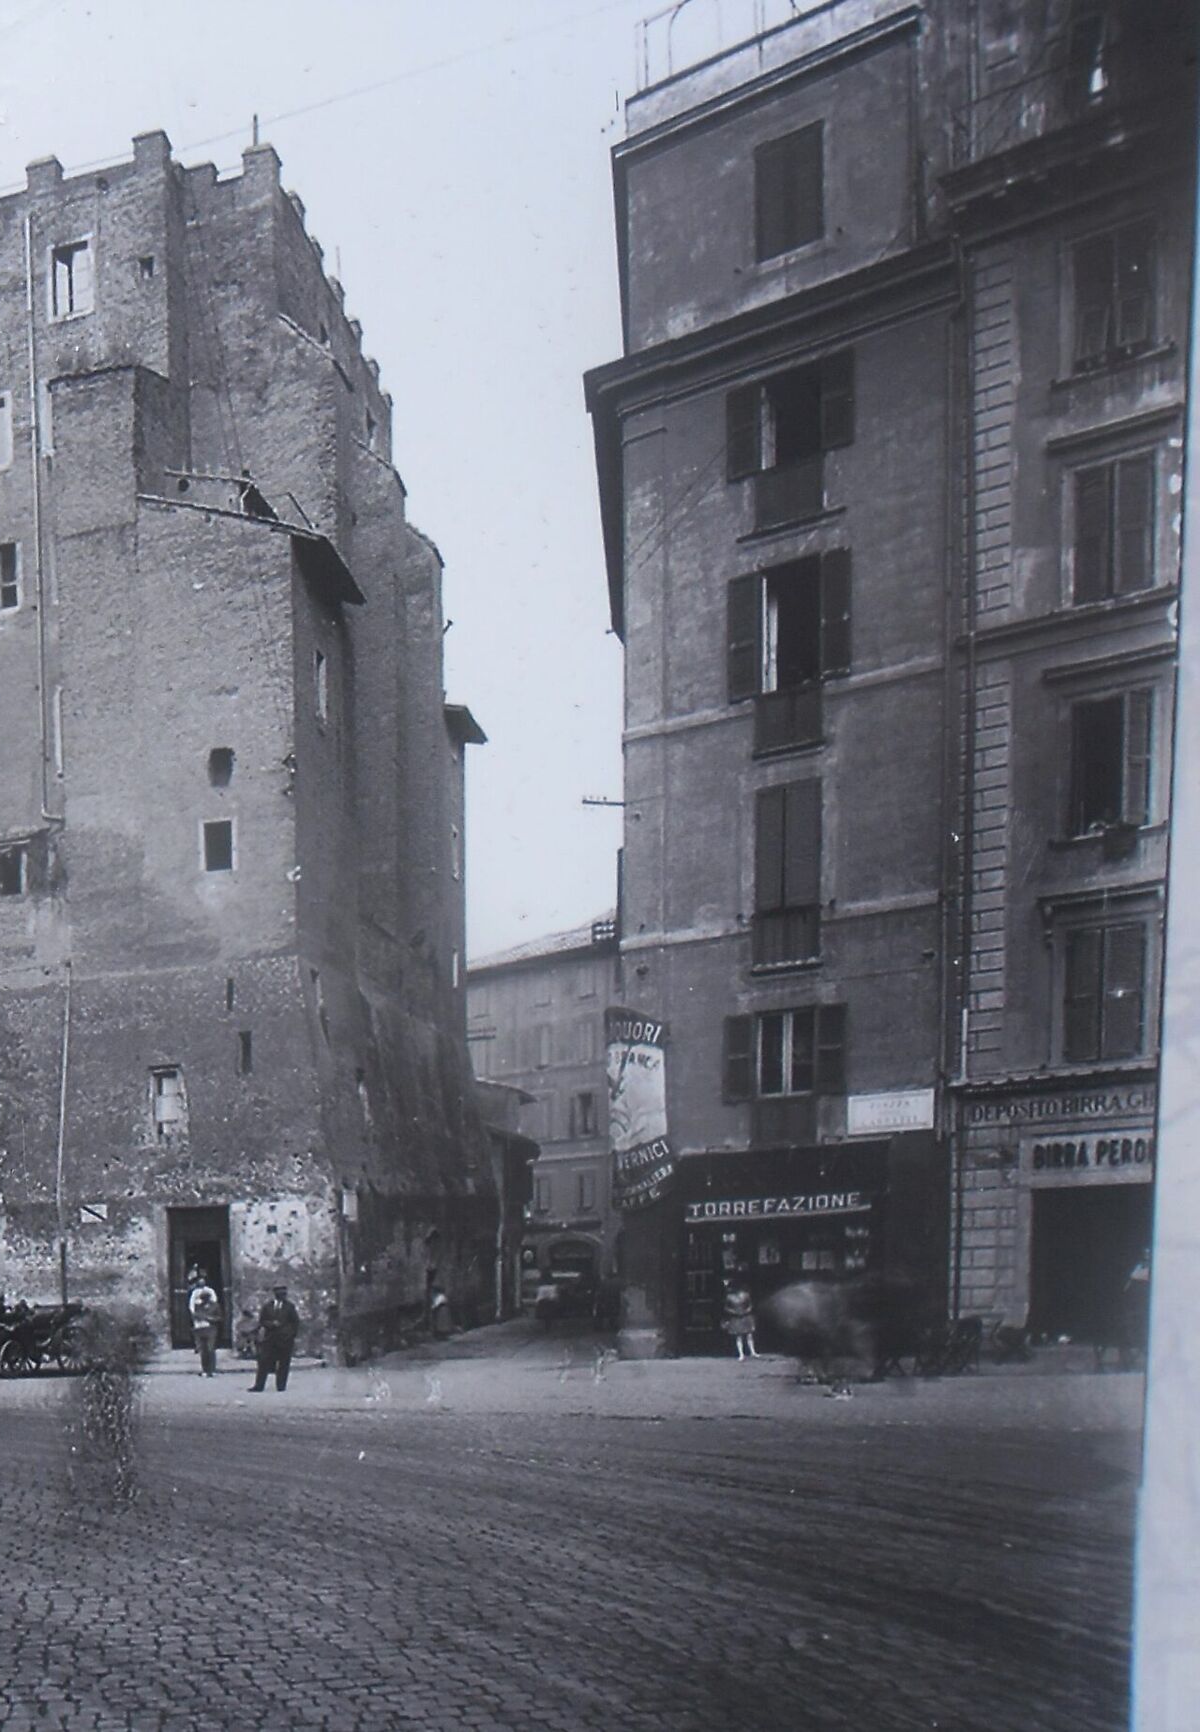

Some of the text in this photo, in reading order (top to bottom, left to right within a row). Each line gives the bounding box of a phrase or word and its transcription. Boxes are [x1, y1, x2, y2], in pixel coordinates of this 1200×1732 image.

[971, 1102, 1057, 1122] DEPOSITO
[1061, 1094, 1124, 1115] BIRRA
[1033, 1141, 1090, 1170] BIRRA
[687, 1191, 862, 1218] TORREFAZIONE
